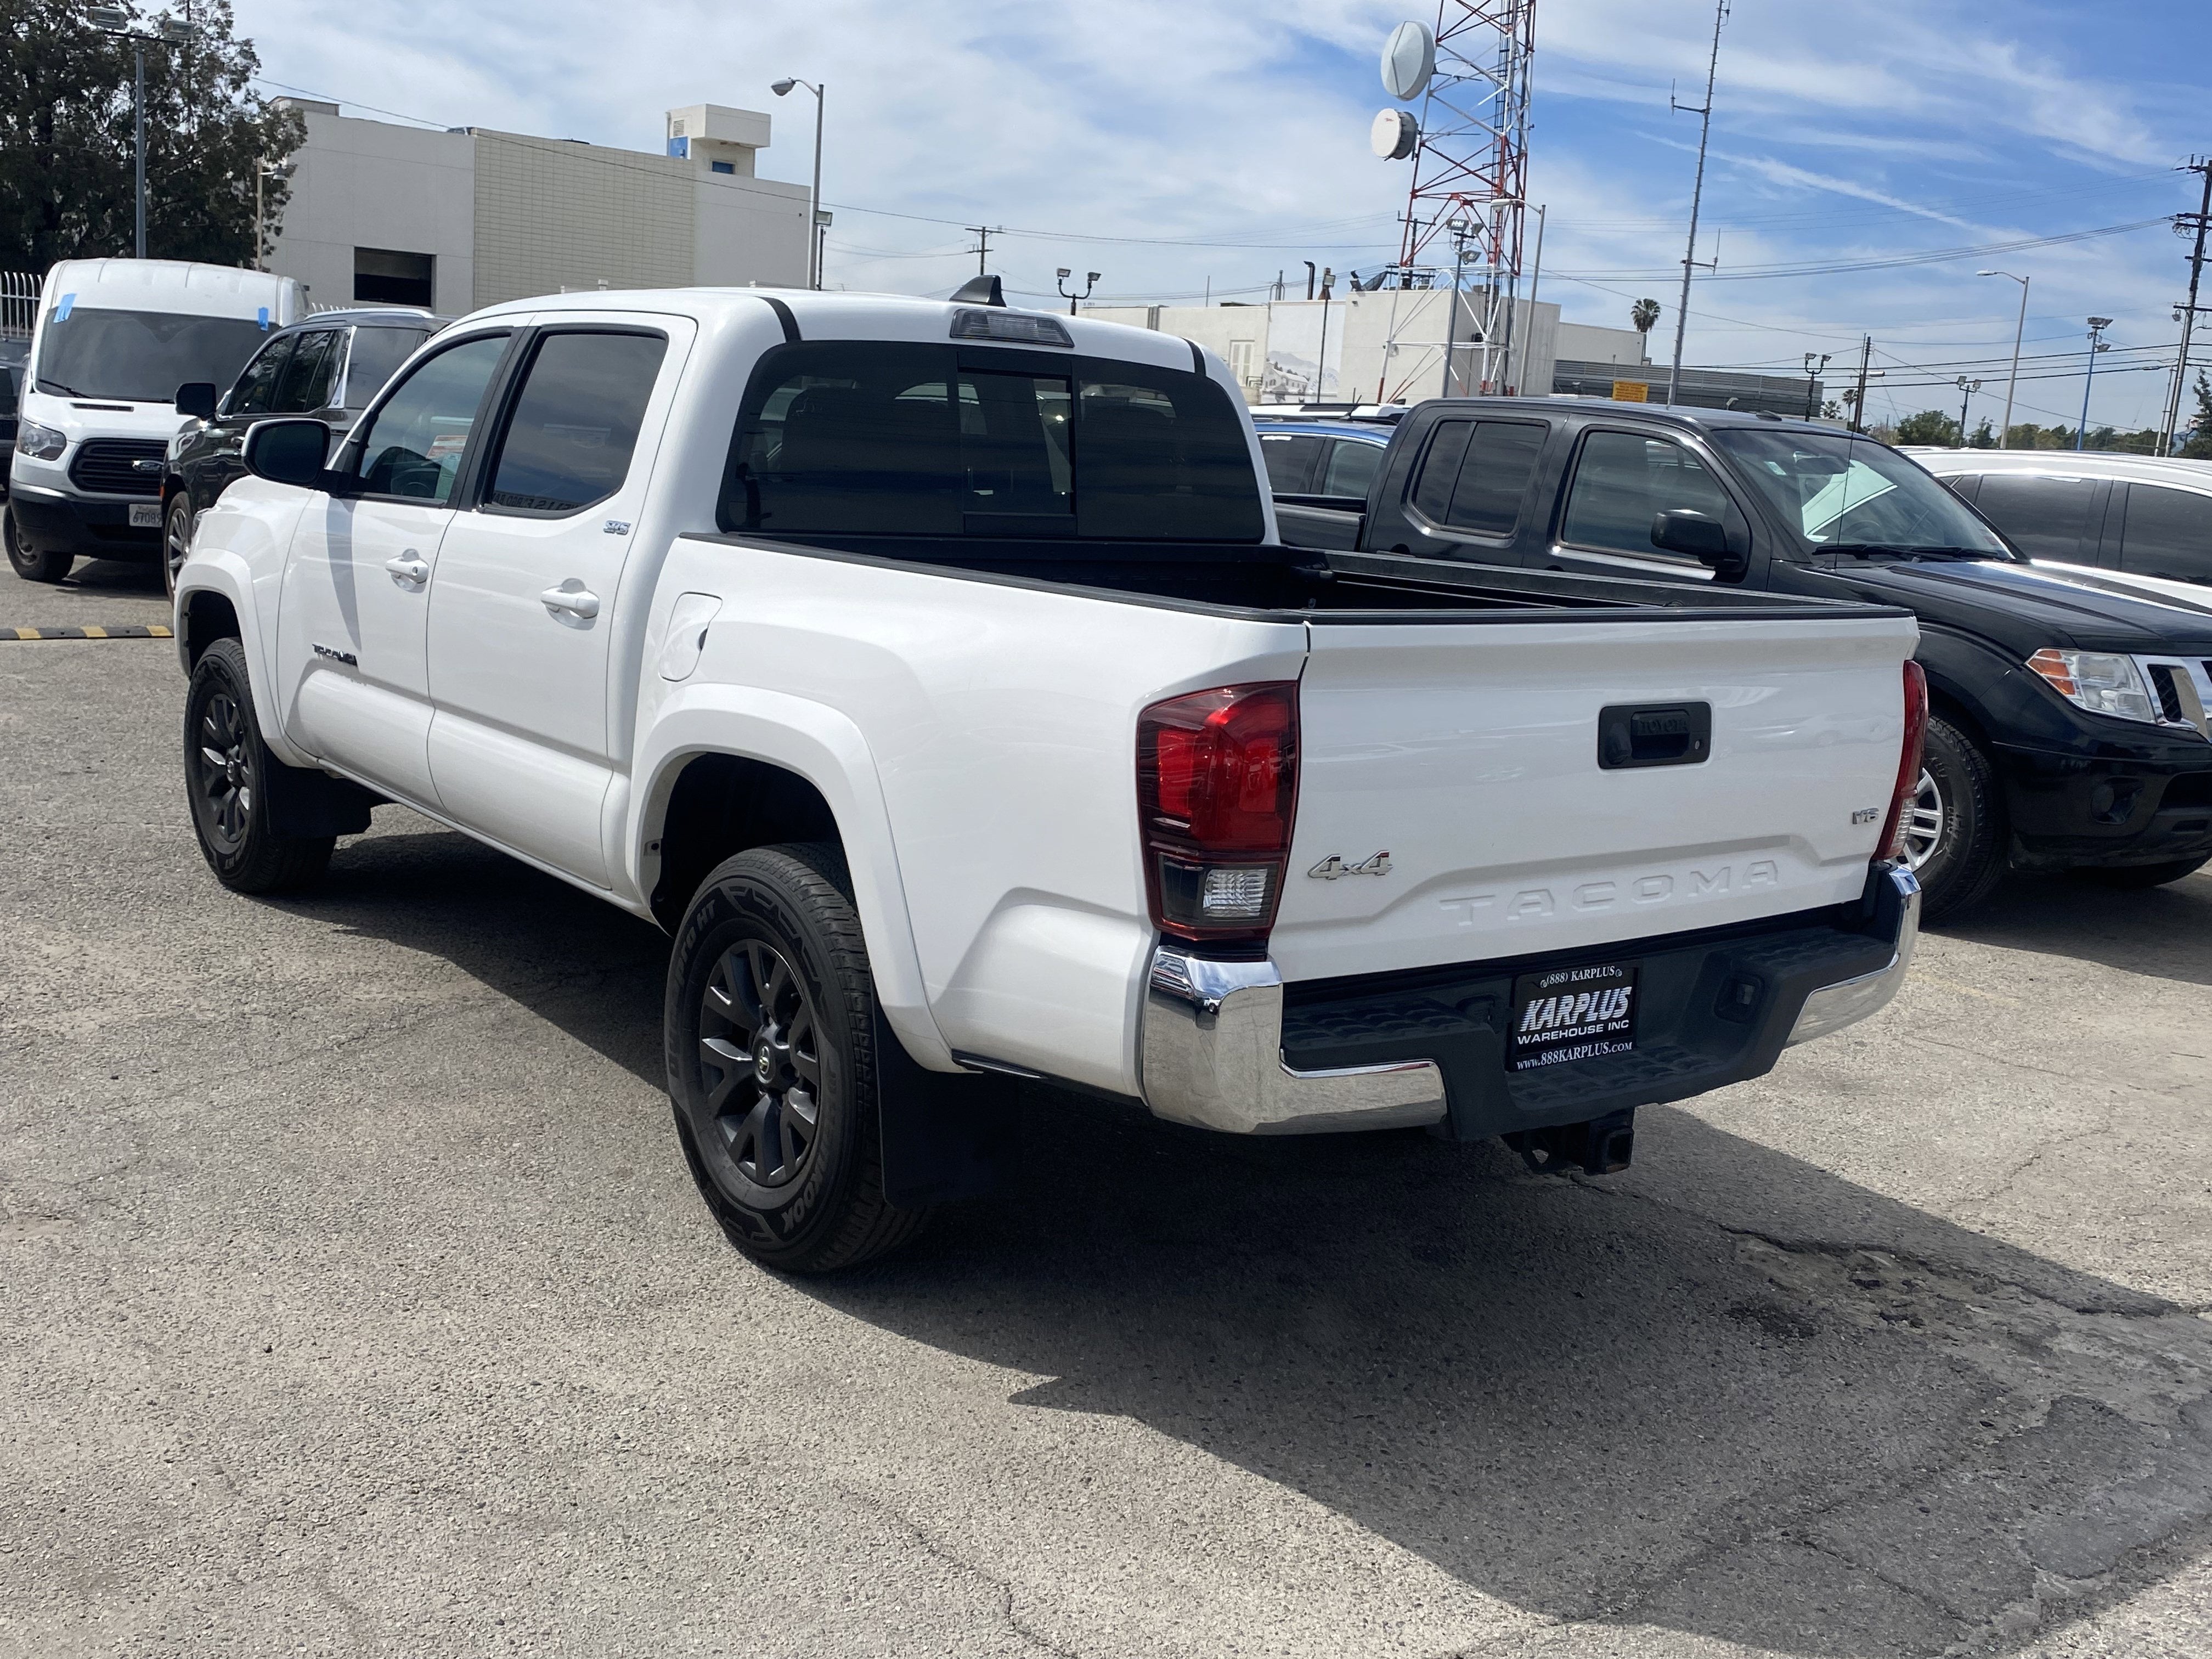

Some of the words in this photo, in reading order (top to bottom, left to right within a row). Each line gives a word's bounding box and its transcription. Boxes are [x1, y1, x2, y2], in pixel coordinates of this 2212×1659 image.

[1439, 860, 1779, 926] TACOMA
[1547, 972, 1568, 986] (888)
[1571, 966, 1615, 982] KARPLUS
[1518, 986, 1632, 1032] KARPLUS
[1517, 1024, 1604, 1045] WAREHOUSE
[1607, 1019, 1629, 1031] INC
